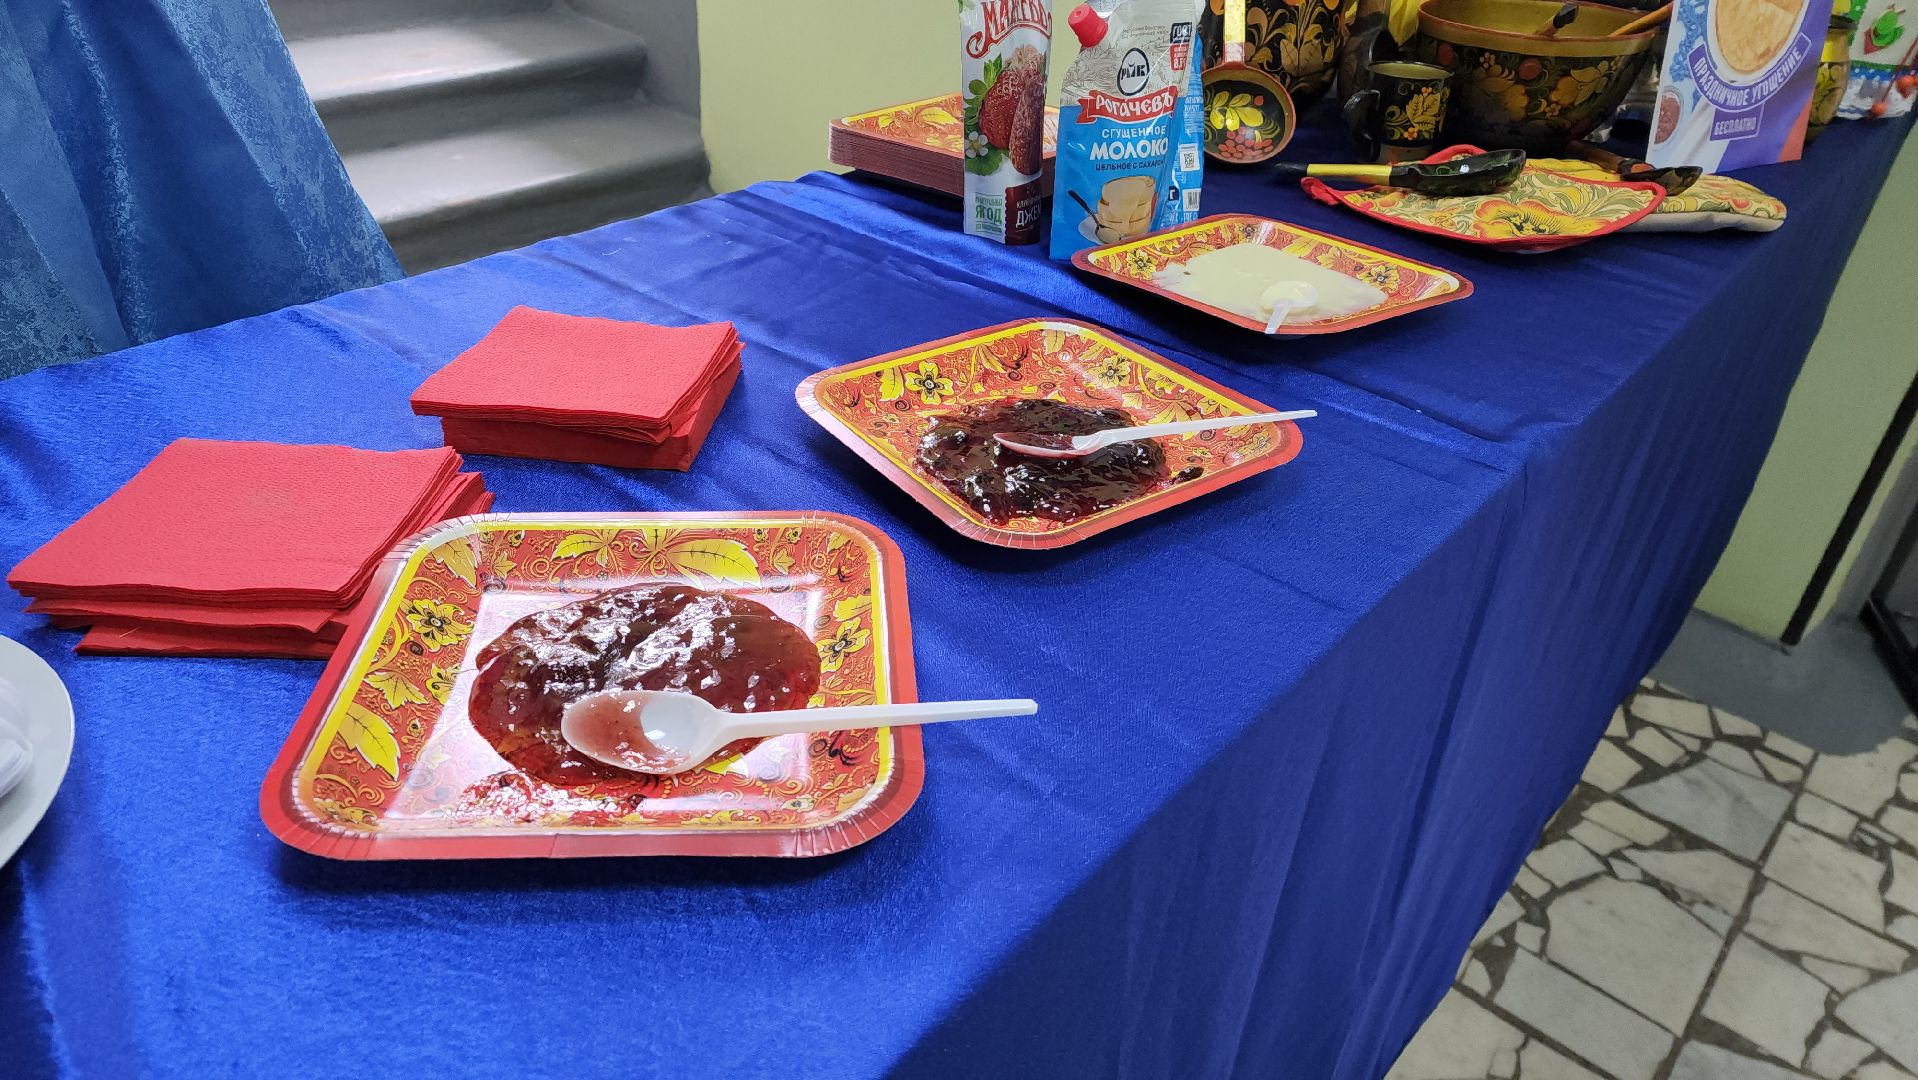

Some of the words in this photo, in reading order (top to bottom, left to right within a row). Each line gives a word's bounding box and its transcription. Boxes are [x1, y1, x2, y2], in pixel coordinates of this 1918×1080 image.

[1693, 56, 1750, 107] ПРАЗДНИЧНОЕ
[1751, 46, 1802, 103] УГОЩЕНИЕ
[1713, 116, 1757, 136] БЕСПЛАТНО
[1089, 137, 1169, 161] МОЛОКО
[1095, 163, 1131, 171] ЦЕЛЬНОЕ
[975, 205, 1002, 225] ЯГОД
